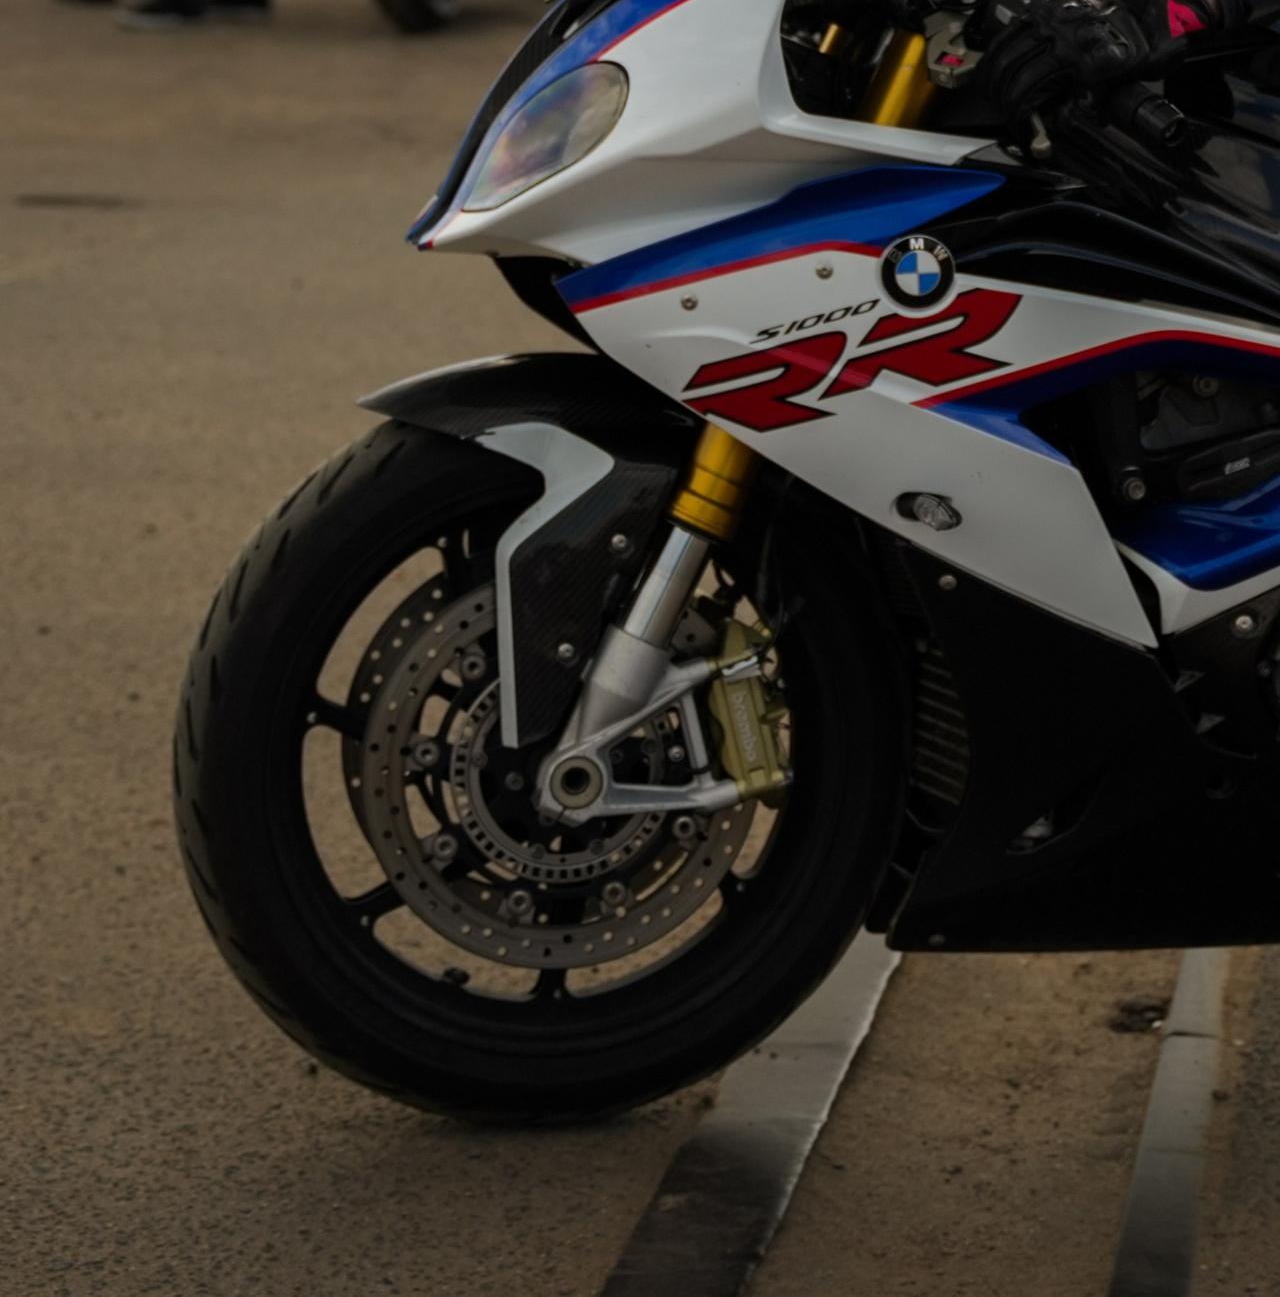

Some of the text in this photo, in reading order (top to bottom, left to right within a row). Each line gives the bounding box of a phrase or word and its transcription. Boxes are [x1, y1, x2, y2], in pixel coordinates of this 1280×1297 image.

[887, 236, 949, 263] BMW
[749, 298, 881, 344] S1000
[681, 287, 1023, 432] RR
[732, 690, 757, 763] brembo
